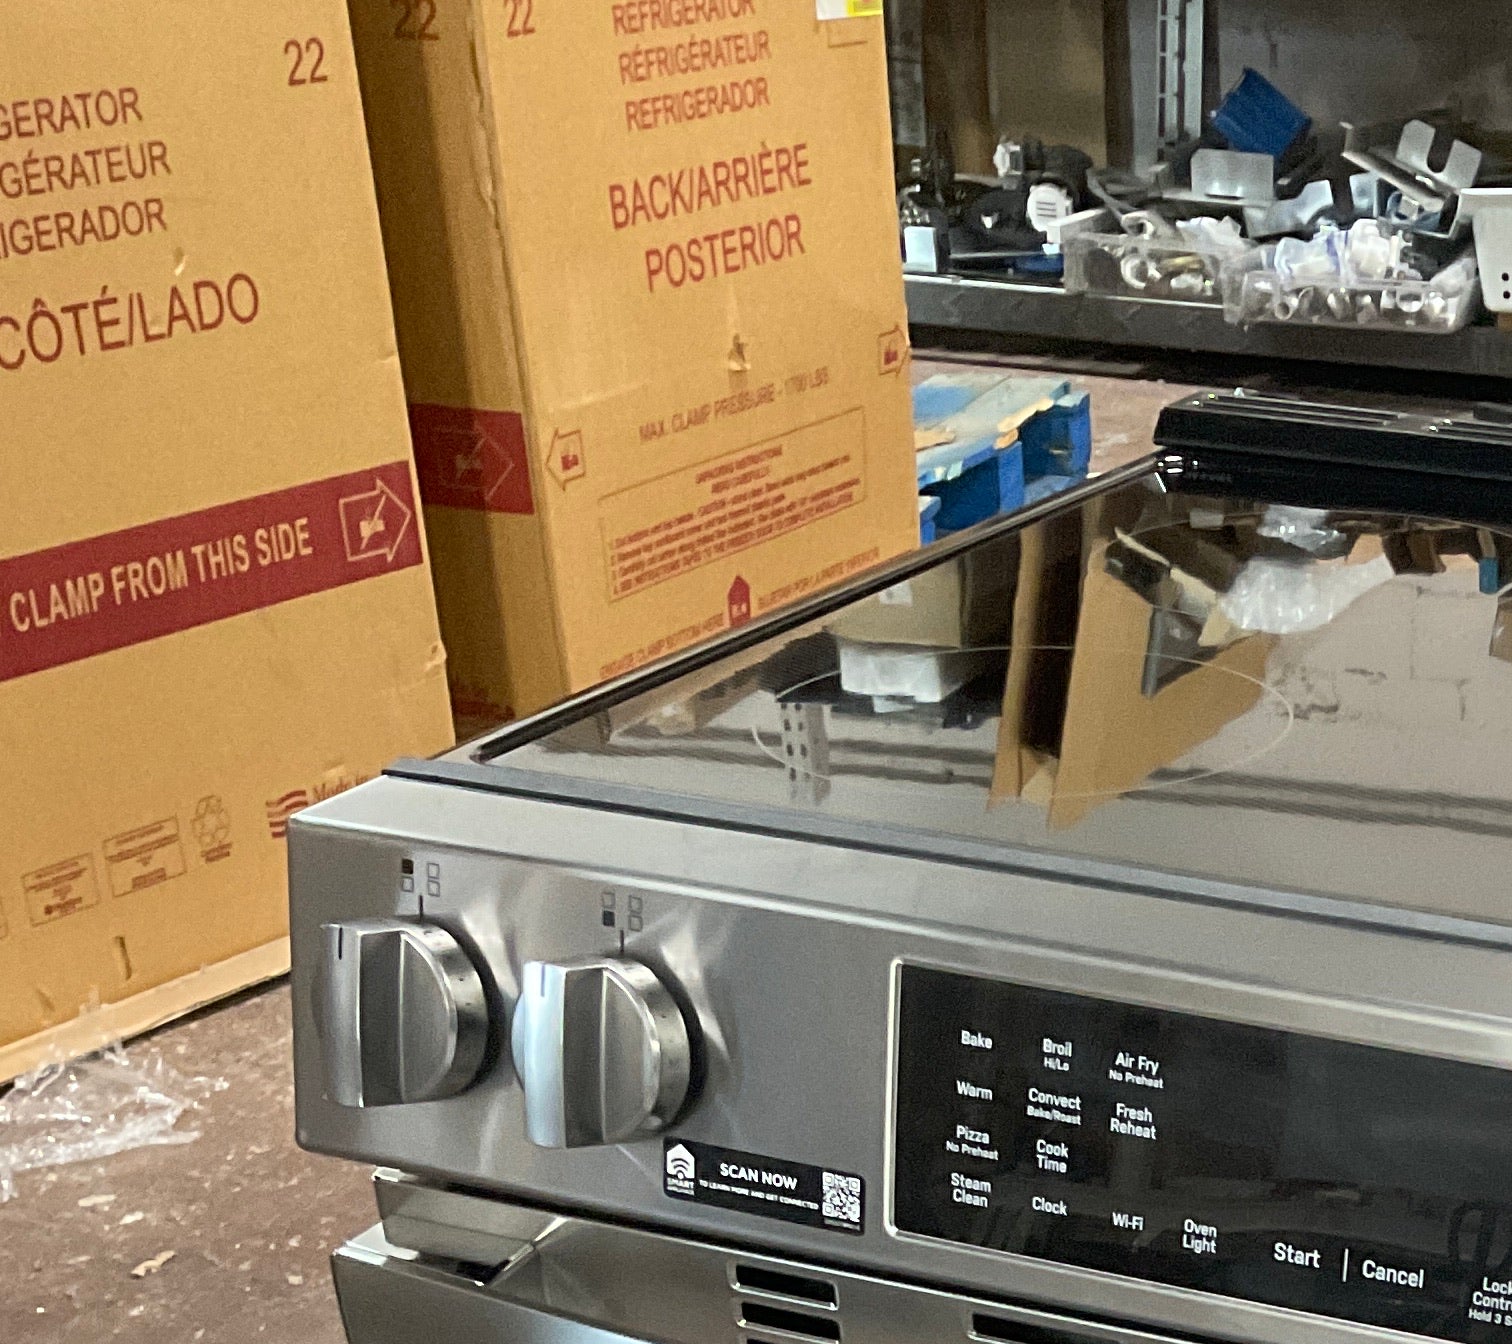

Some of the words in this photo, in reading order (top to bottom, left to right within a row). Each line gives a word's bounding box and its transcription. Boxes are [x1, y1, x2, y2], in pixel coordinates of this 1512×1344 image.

[284, 37, 328, 86] 22
[619, 30, 772, 86] RÉFRIGÉRATEUR
[625, 77, 770, 132] REFRIGERADOR
[608, 141, 813, 230] BACK/ARRIÈRE
[0, 198, 167, 260] IGERADOR
[645, 214, 805, 293] POSTERIOR
[0, 273, 259, 370] CÔTÉ/LADO
[10, 572, 105, 632] CLAMP
[111, 550, 188, 605] FROM
[191, 534, 250, 582] THIS
[254, 517, 313, 566] SIDE
[961, 1030, 992, 1049] Bake
[1043, 1038, 1072, 1057] Broil
[1115, 1052, 1134, 1068] Air
[1138, 1055, 1159, 1075] Fry
[1109, 1069, 1122, 1082] No
[1125, 1072, 1163, 1089] Preheat
[957, 1081, 993, 1100] Warm
[1028, 1087, 1081, 1111] Convect
[1026, 1105, 1081, 1125] Bake/Roast
[1116, 1103, 1152, 1122] Fresh
[956, 1125, 990, 1144] Pizza
[1110, 1118, 1156, 1140] Reheat
[946, 1140, 959, 1152] No
[961, 1143, 998, 1161] Preheat
[1036, 1139, 1068, 1158] Cook
[1037, 1154, 1067, 1173] Time
[719, 1163, 759, 1183] SCAN
[761, 1171, 798, 1190] NOW
[951, 1173, 991, 1193] Steam
[953, 1189, 988, 1208] Clean
[1032, 1196, 1068, 1216] Clock
[1112, 1212, 1144, 1231] Wi-Fi
[1184, 1219, 1217, 1238] Oven
[1183, 1234, 1216, 1254] Light
[1274, 1242, 1321, 1269] Start
[1362, 1260, 1425, 1289] Cancel
[1468, 1308, 1492, 1322] Hold
[1494, 1313, 1502, 1325] 3
